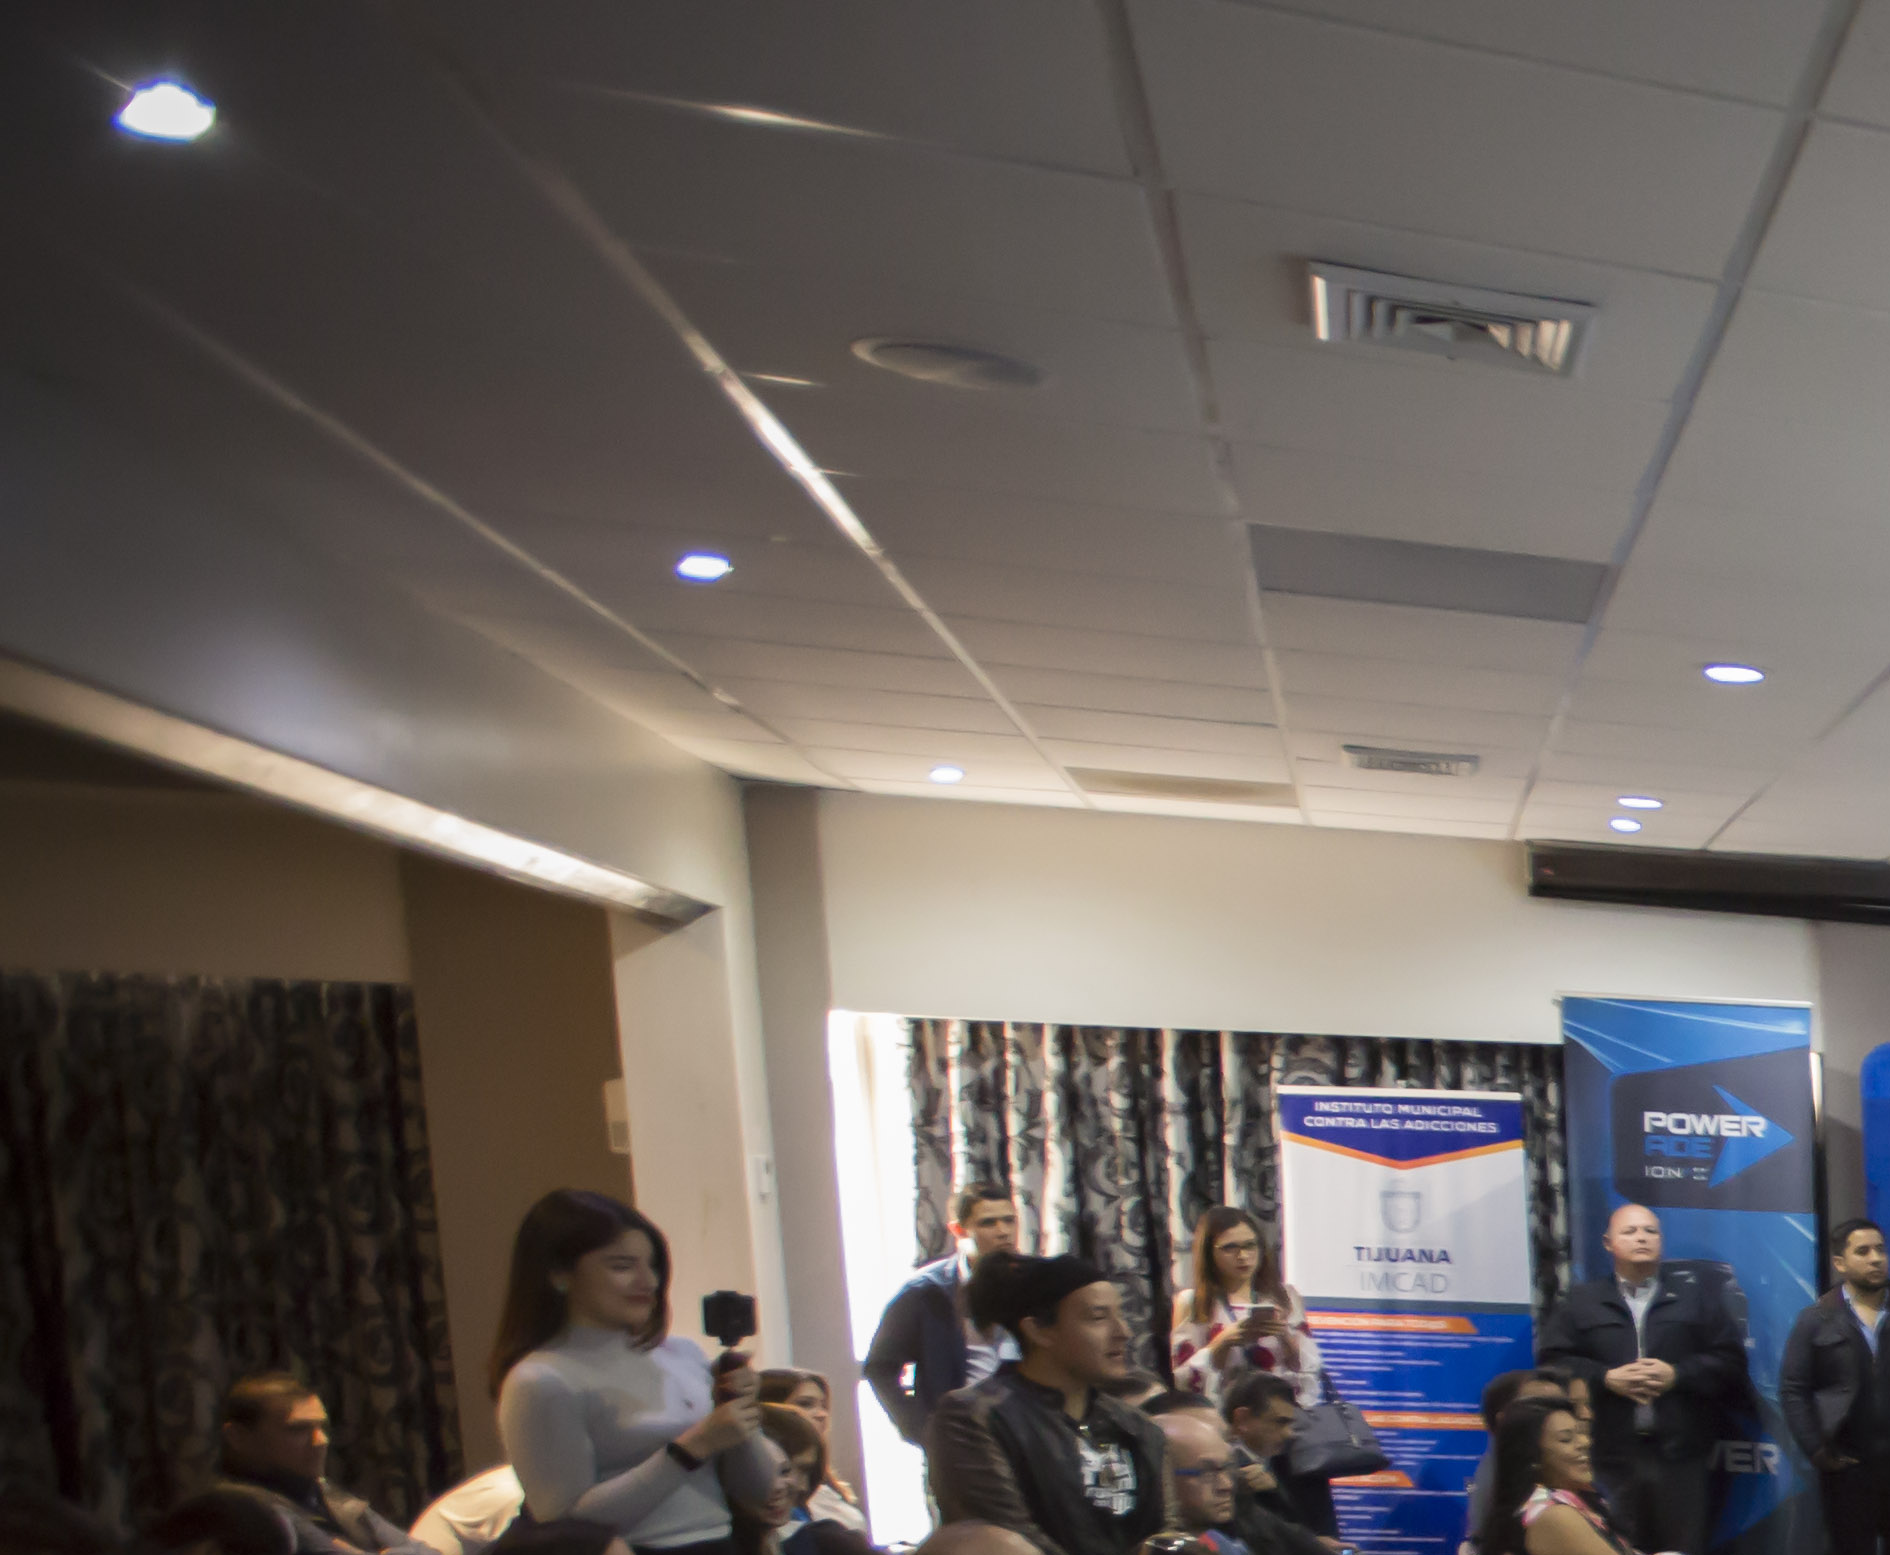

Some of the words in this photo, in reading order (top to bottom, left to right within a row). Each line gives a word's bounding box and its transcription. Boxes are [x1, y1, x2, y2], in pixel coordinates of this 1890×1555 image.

[1314, 1101, 1394, 1115] INSTITUTO
[1398, 1103, 1484, 1118] MUNICIPAL
[1303, 1115, 1367, 1129] CONTRA
[1371, 1117, 1400, 1130] LAS
[1404, 1119, 1498, 1133] ADICCIONES
[1643, 1111, 1769, 1138] POWER
[1353, 1246, 1453, 1265] TIJUANA
[1361, 1272, 1449, 1294] IMCAD
